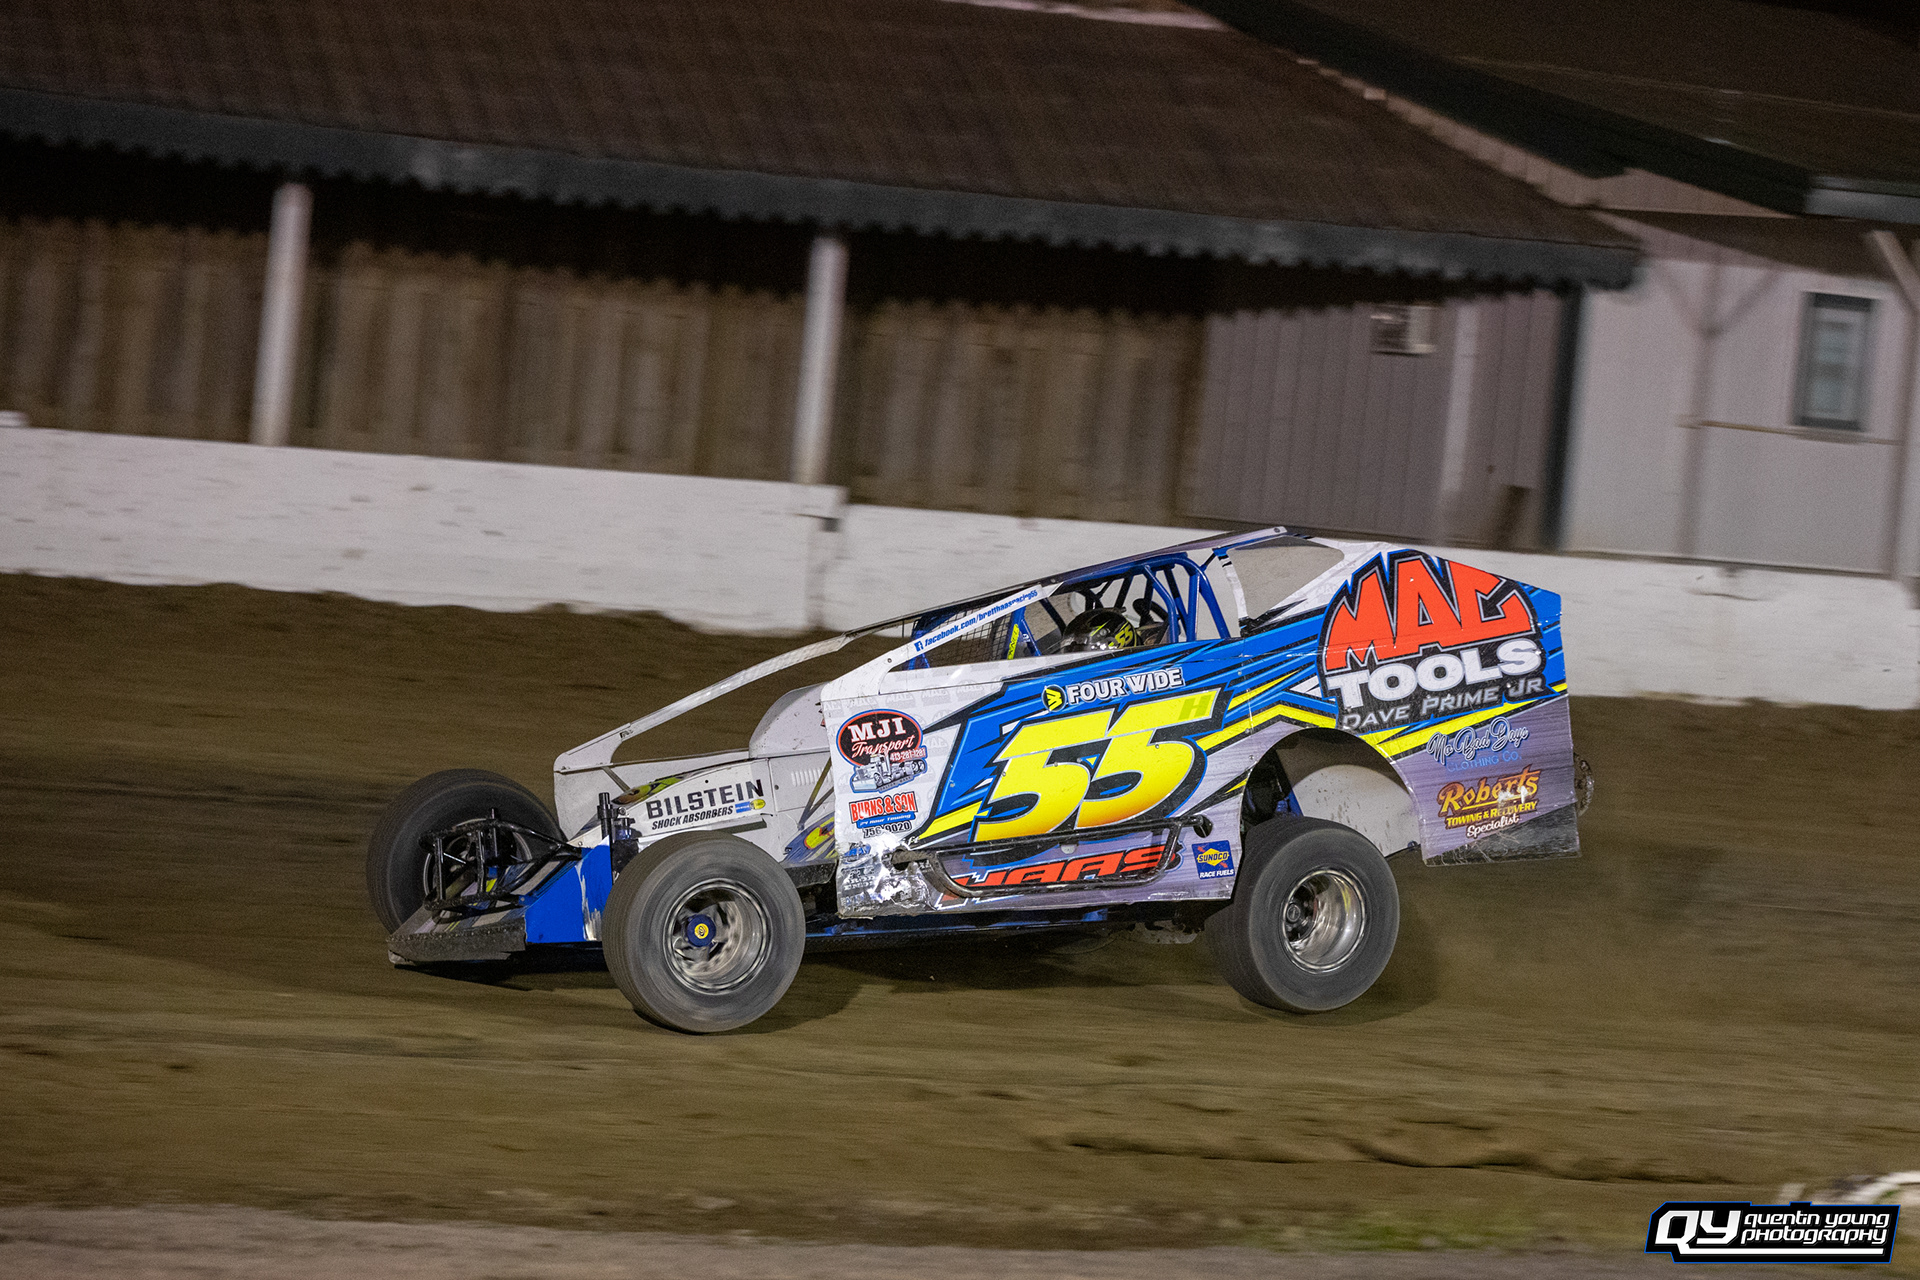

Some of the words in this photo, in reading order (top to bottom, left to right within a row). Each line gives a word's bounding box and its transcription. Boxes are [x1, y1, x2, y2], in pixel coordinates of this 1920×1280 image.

[1324, 555, 1535, 672] MAC
[1067, 676, 1126, 704] FOUR
[1125, 667, 1185, 695] WIDE
[1326, 638, 1541, 709] TOOLS
[1179, 691, 1211, 721] H
[1342, 706, 1410, 730] DAVE
[1422, 686, 1499, 715] PRIME
[1508, 677, 1543, 697] JR
[848, 717, 906, 742] MJI
[1453, 726, 1490, 760] Bad
[852, 734, 915, 758] Transport
[975, 687, 1221, 842] 55
[1447, 756, 1499, 772] CLOTHING
[646, 779, 764, 819] BILSTEIN
[1439, 766, 1541, 813] Roberts
[651, 818, 681, 830] SHOCK
[682, 805, 734, 824] ABSORBERS
[850, 797, 884, 822] BURNS
[884, 796, 895, 813] &
[894, 793, 916, 812] SON
[1446, 813, 1482, 827] TOWING
[1490, 801, 1537, 817] RECOVERY
[1467, 813, 1519, 837] Specialist
[1198, 852, 1228, 862] SUNOCO
